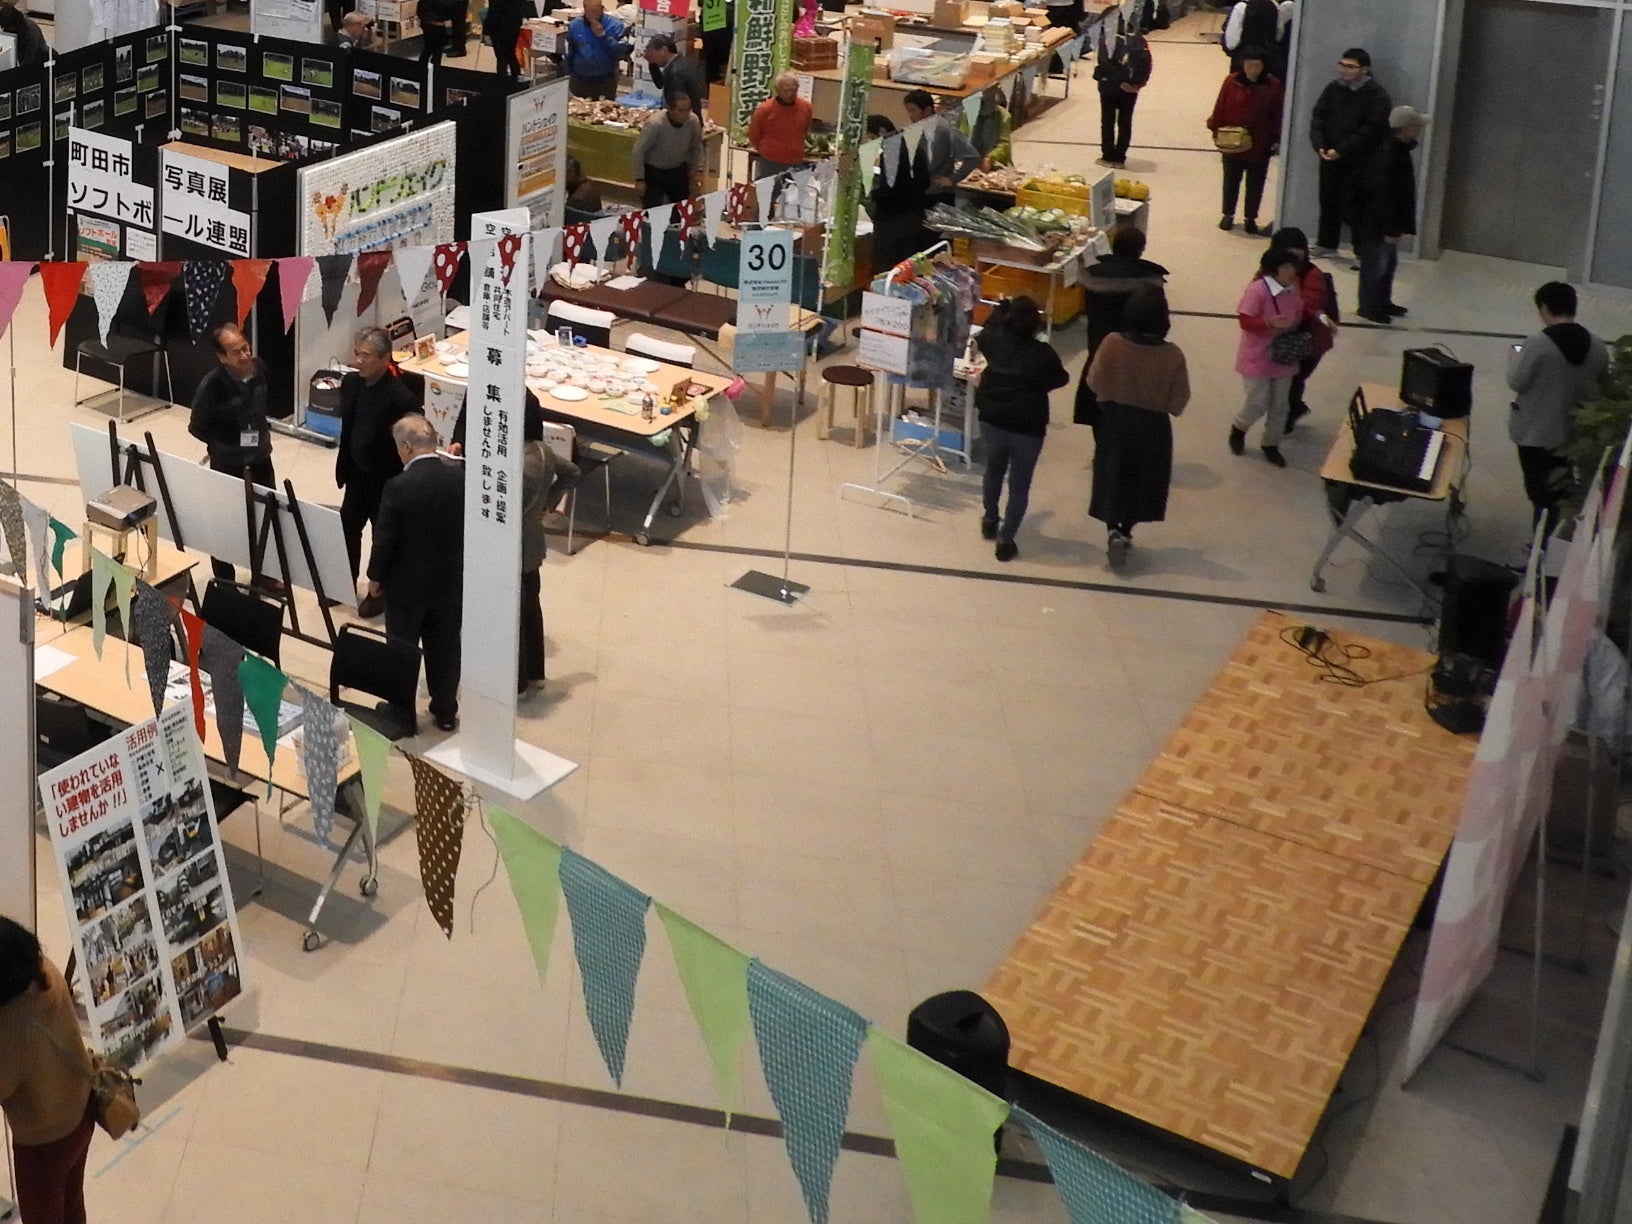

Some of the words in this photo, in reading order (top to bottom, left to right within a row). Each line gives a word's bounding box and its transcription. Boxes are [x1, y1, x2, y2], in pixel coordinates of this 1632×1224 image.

[71, 141, 130, 177] 町田市
[71, 181, 152, 224] ソフトボ
[165, 163, 227, 205] 写真展
[164, 214, 248, 254] ール連盟
[747, 243, 786, 271] 30
[125, 722, 158, 751] 活用例
[51, 753, 120, 801] 「使われていな
[56, 770, 123, 819] い建物を活用
